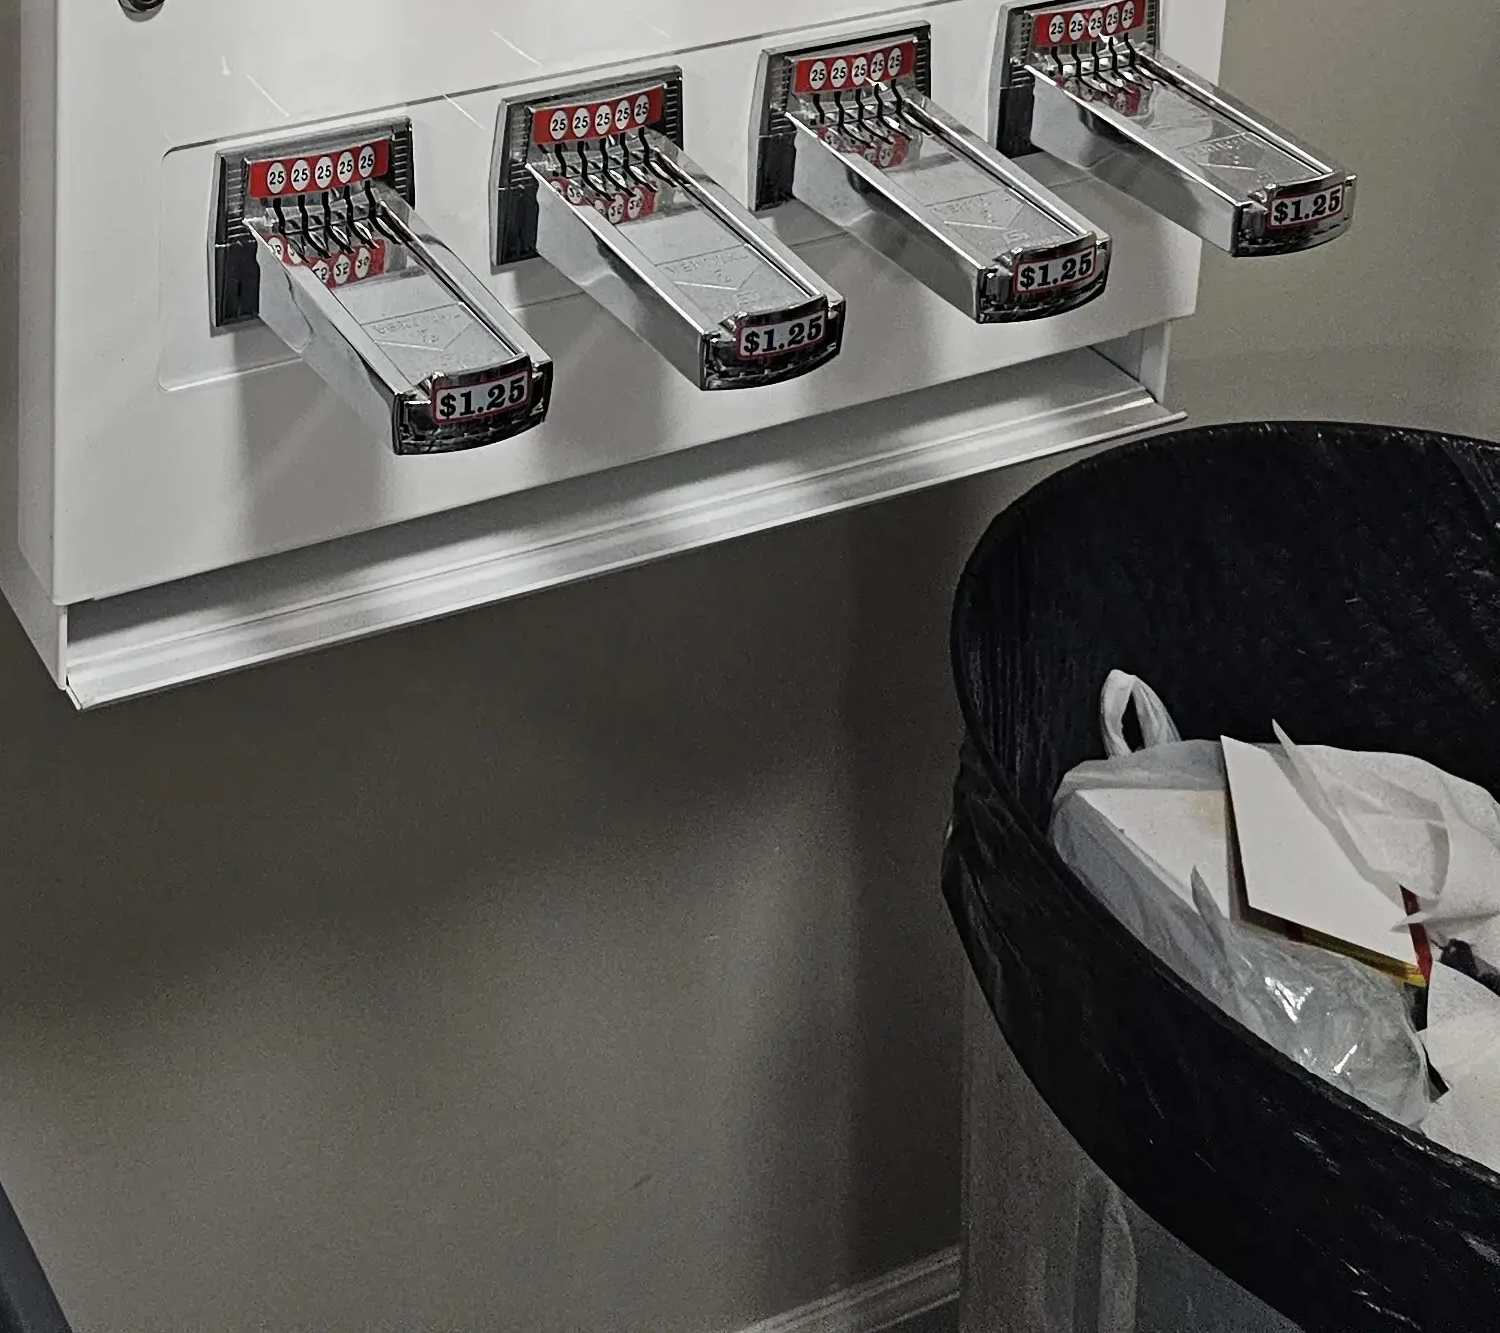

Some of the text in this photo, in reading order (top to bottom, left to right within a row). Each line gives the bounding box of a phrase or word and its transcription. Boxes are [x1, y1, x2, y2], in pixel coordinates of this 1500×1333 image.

[1051, 8, 1134, 35] 25 25 25 25 25
[811, 55, 901, 82] 25 25 25 25 25
[551, 103, 648, 132] 25 25 25 25 25
[269, 154, 374, 185] 25 25 25 25 25
[1273, 188, 1341, 224] $1.25
[1020, 251, 1093, 290] $1.25
[743, 315, 823, 355] $1.25
[439, 375, 526, 420] $1.25
